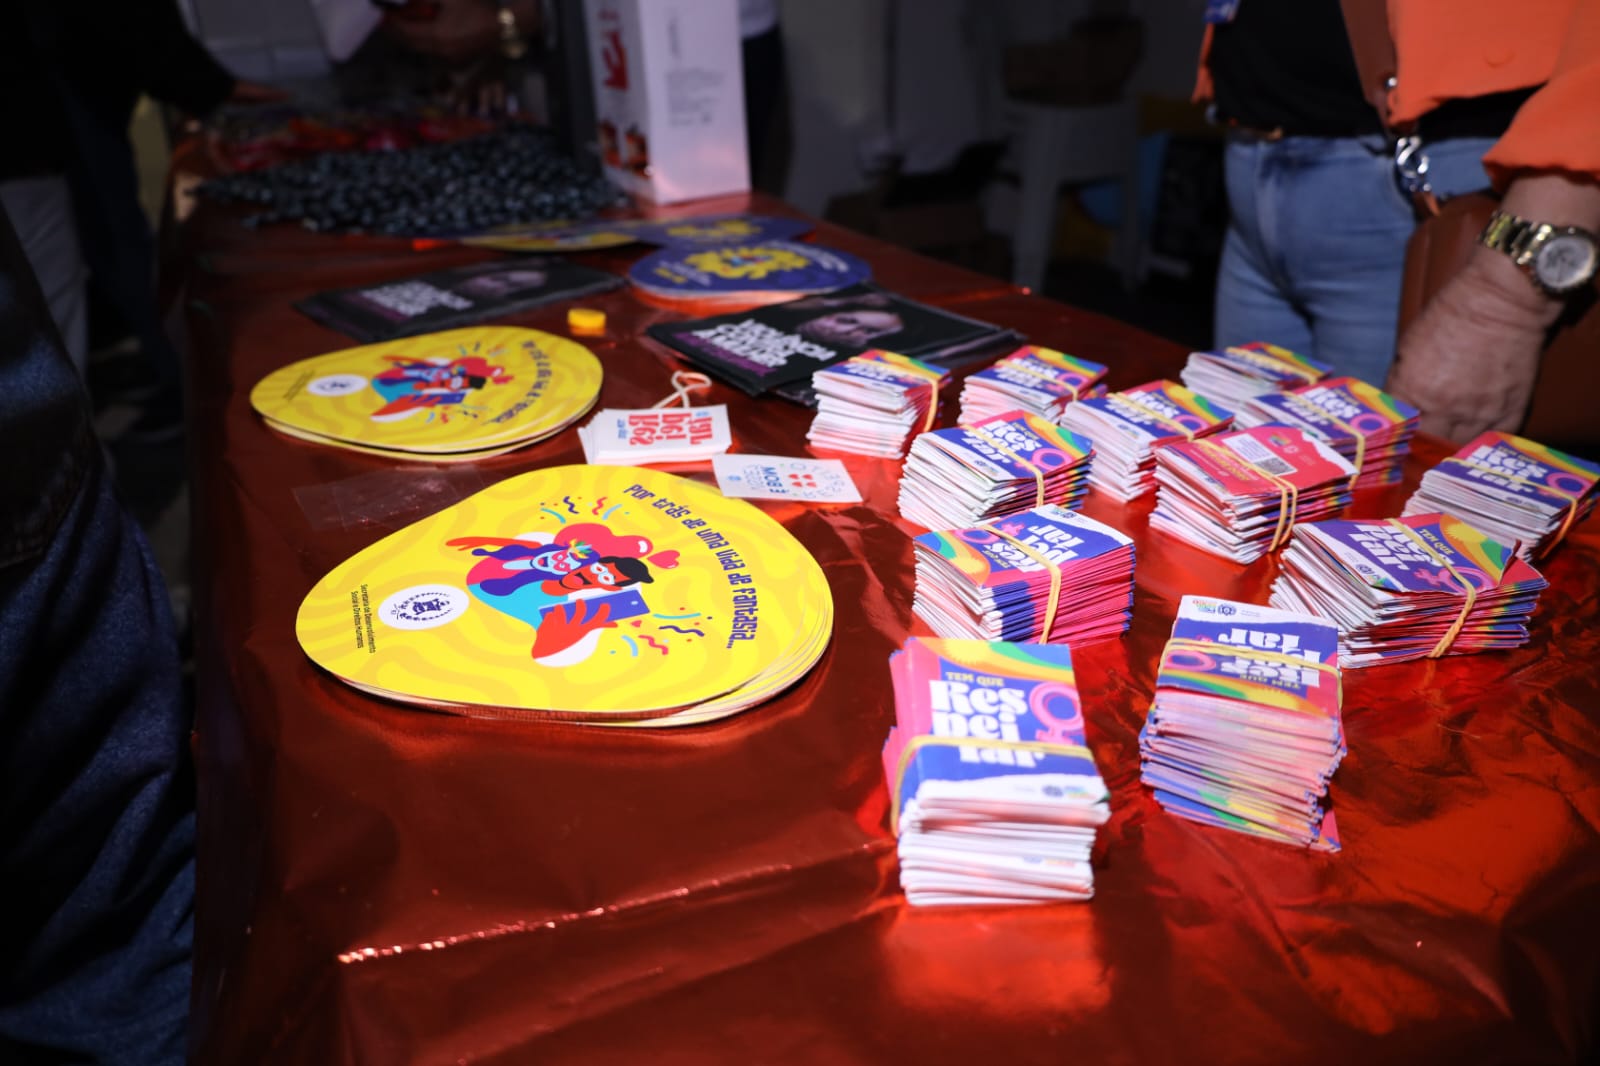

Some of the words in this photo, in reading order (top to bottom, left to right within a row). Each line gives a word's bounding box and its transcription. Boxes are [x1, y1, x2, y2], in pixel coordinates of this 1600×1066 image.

[623, 483, 656, 500] Por
[652, 497, 691, 519] trás
[681, 518, 707, 529] de
[696, 528, 730, 550] uma
[727, 572, 753, 586] de
[1027, 524, 1085, 550] tar
[1353, 524, 1433, 562] pei
[1419, 528, 1439, 541] TEM
[1434, 542, 1455, 555] QUE
[1347, 533, 1410, 570] tar
[1218, 628, 1299, 653] tar
[945, 671, 975, 684] TEM
[976, 675, 1005, 687] QUE
[929, 680, 1028, 715] Res
